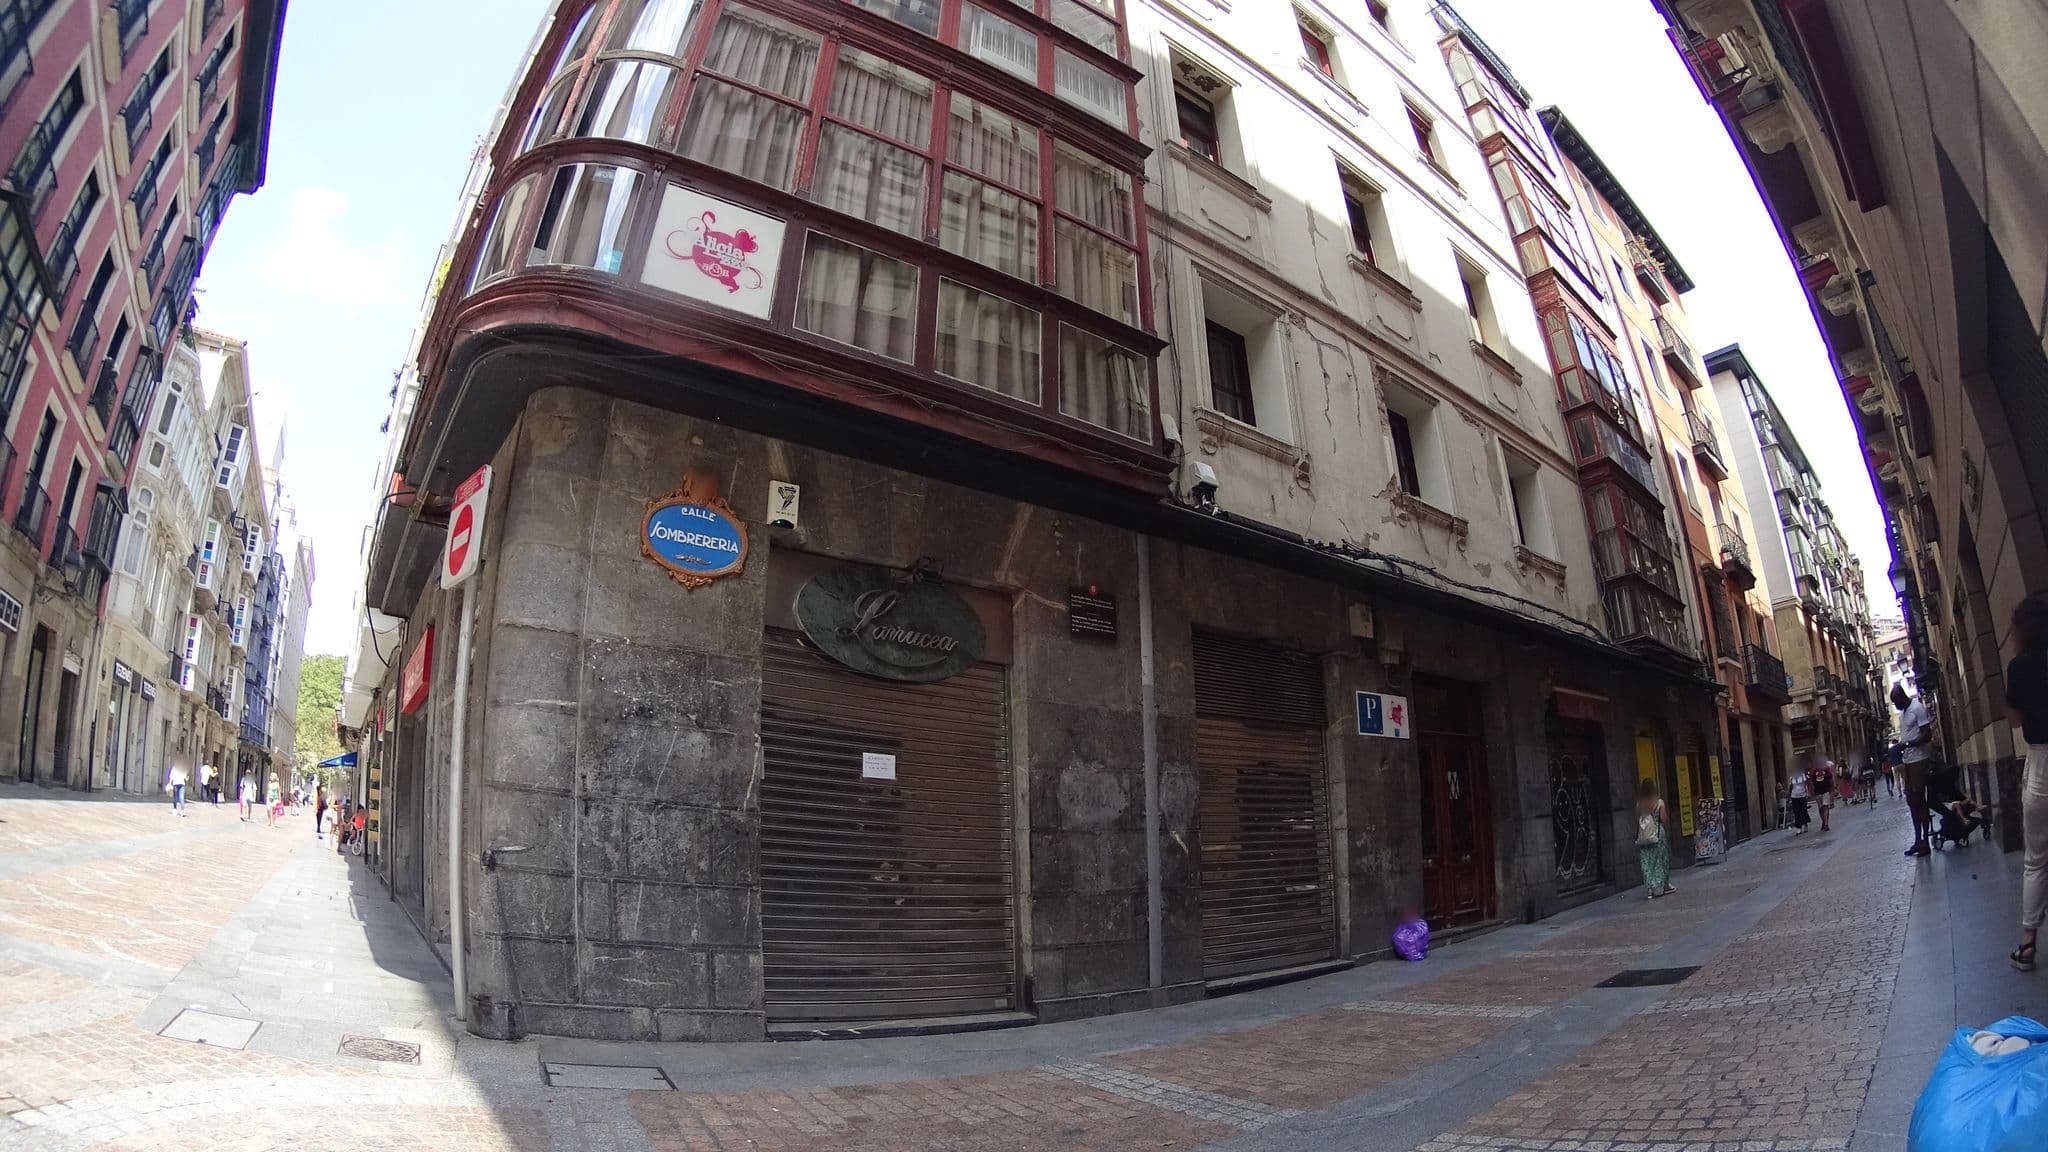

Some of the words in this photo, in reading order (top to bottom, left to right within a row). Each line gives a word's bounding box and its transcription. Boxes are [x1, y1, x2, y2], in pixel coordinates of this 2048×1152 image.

[693, 229, 744, 261] Alicia
[681, 507, 717, 522] CALLE
[1366, 698, 1376, 719] P
